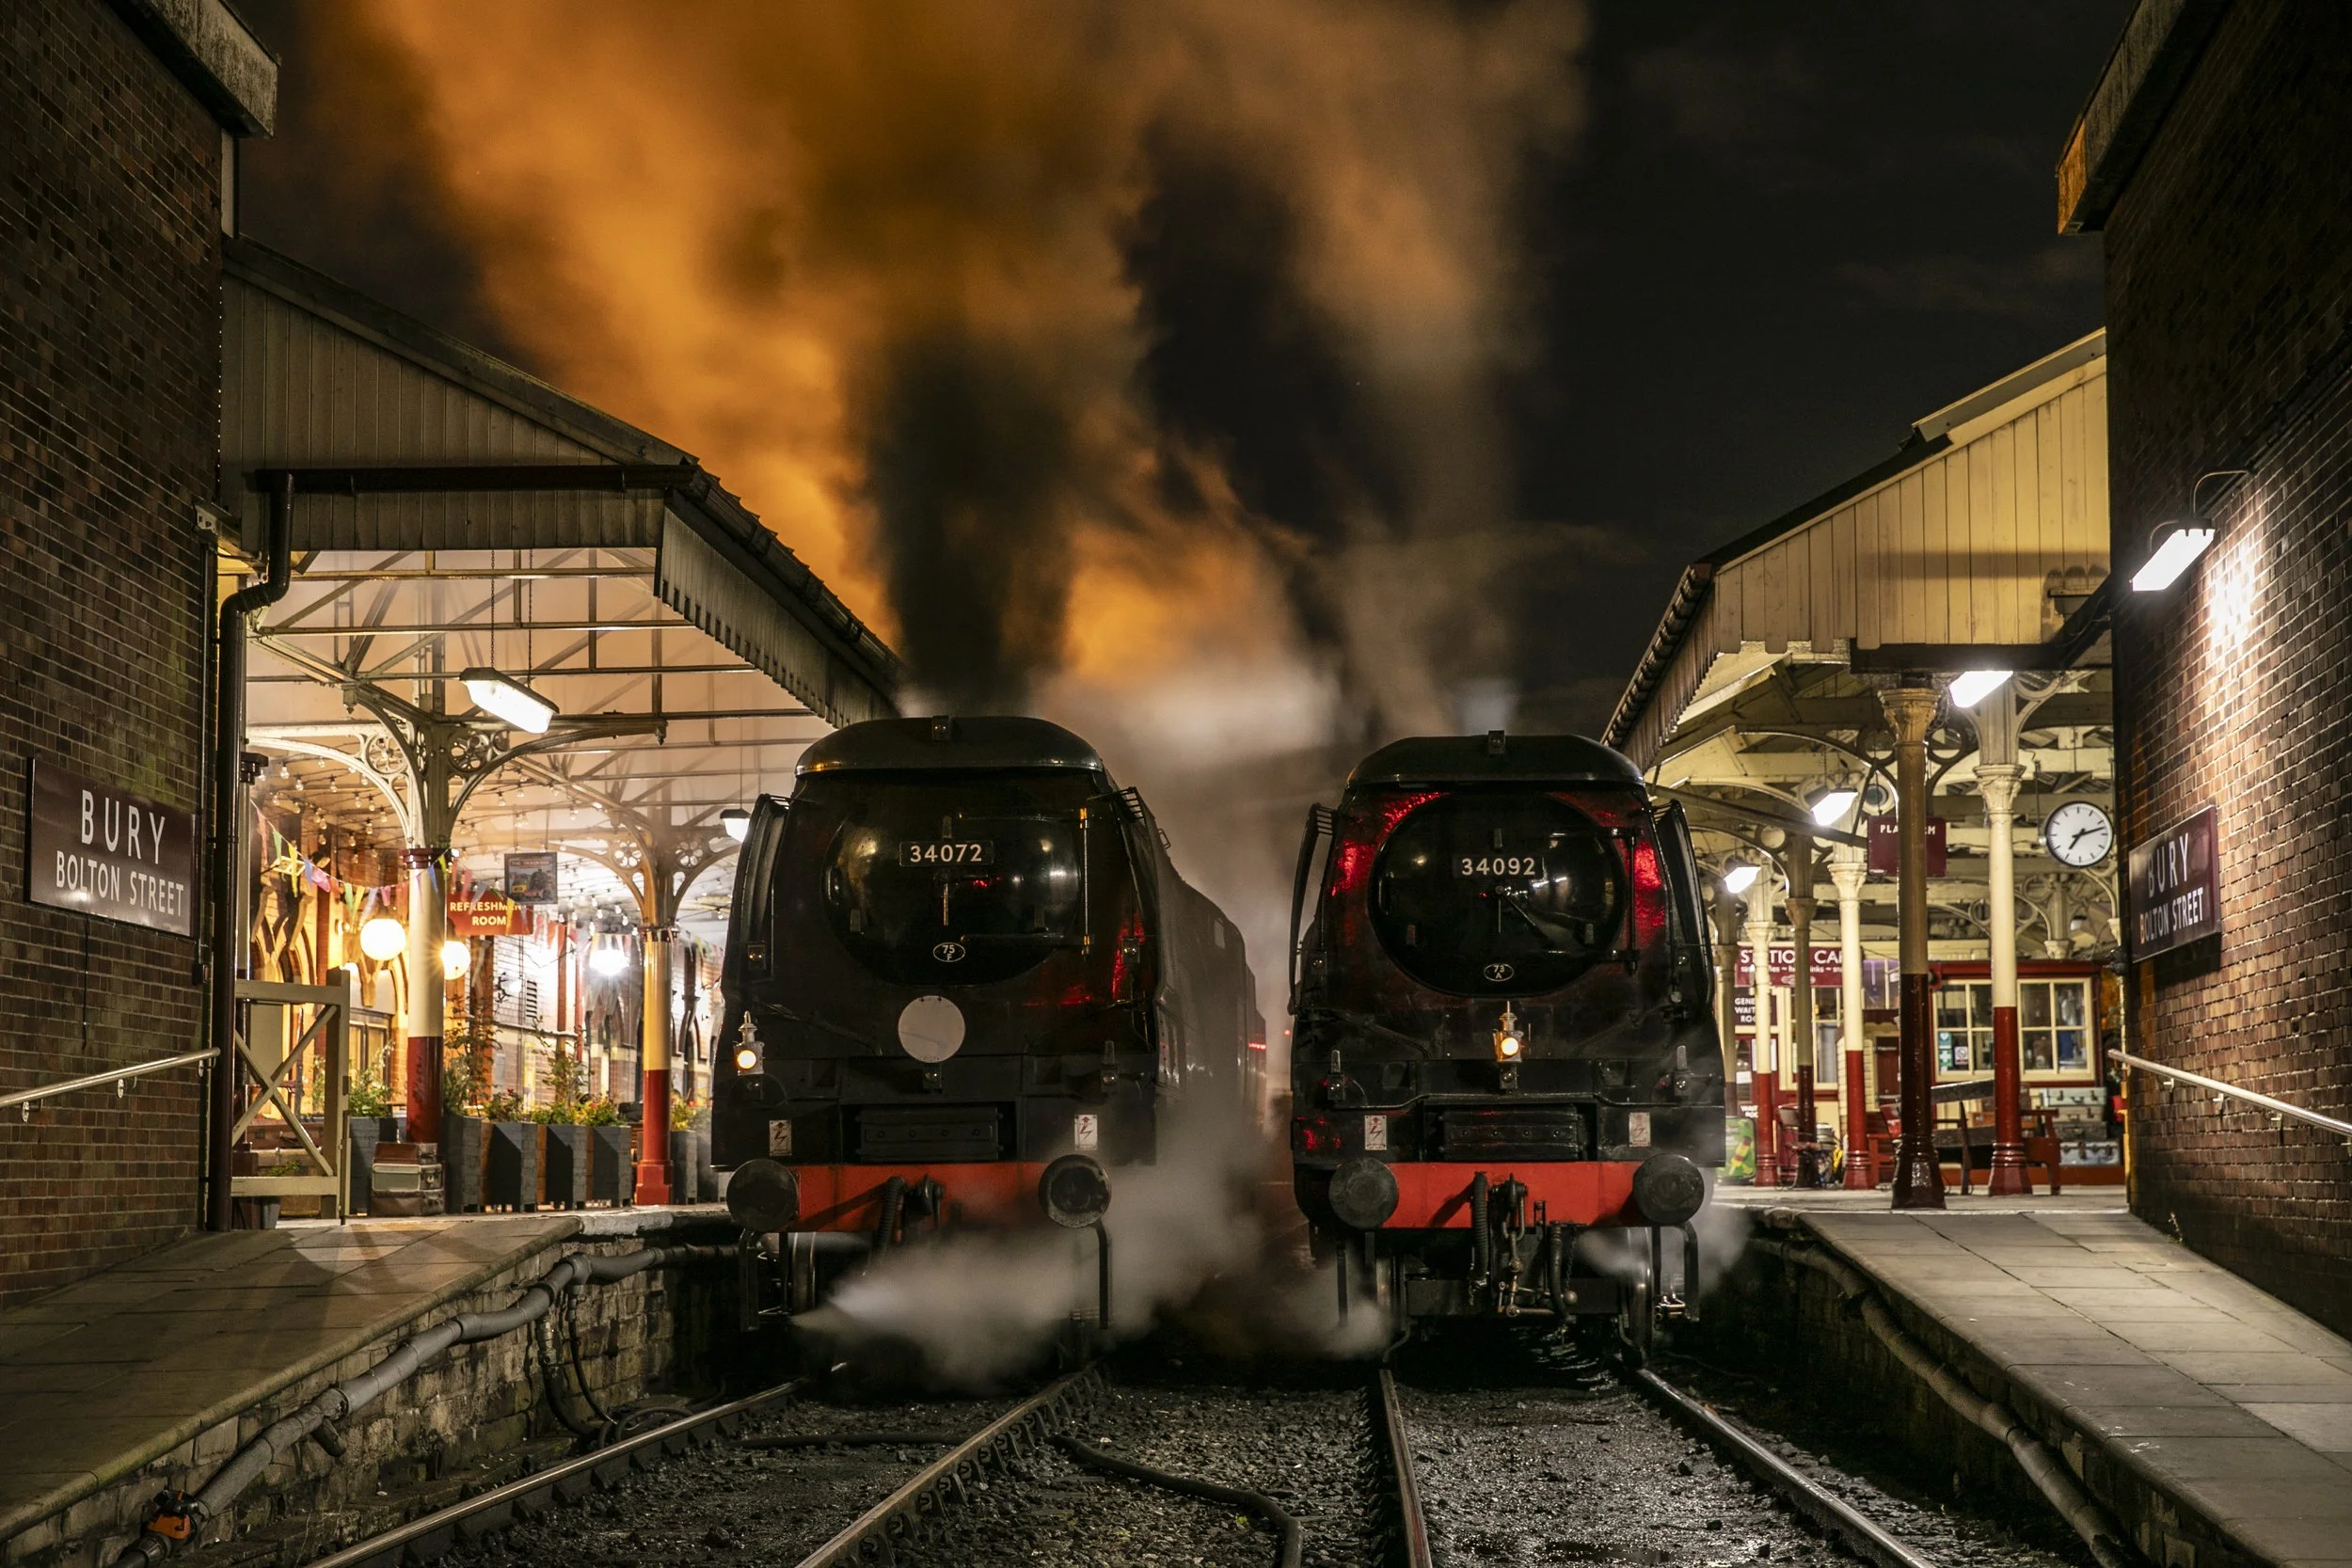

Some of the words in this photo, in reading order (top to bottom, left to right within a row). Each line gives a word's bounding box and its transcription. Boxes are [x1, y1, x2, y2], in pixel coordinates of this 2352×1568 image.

[81, 789, 166, 864] BURY
[1880, 824, 1936, 835] PLAM
[910, 844, 982, 863] 34072
[1462, 857, 1535, 876] 34092
[2148, 832, 2189, 897] BURY
[56, 849, 120, 902] BOLTON
[129, 871, 184, 917] STREET
[471, 915, 506, 927] ROOM
[2139, 903, 2169, 944] BOLTON
[2172, 886, 2204, 931] STREET
[942, 944, 956, 954] 75
[1734, 997, 1756, 1006] GENE
[1734, 1006, 1756, 1015] WAIT
